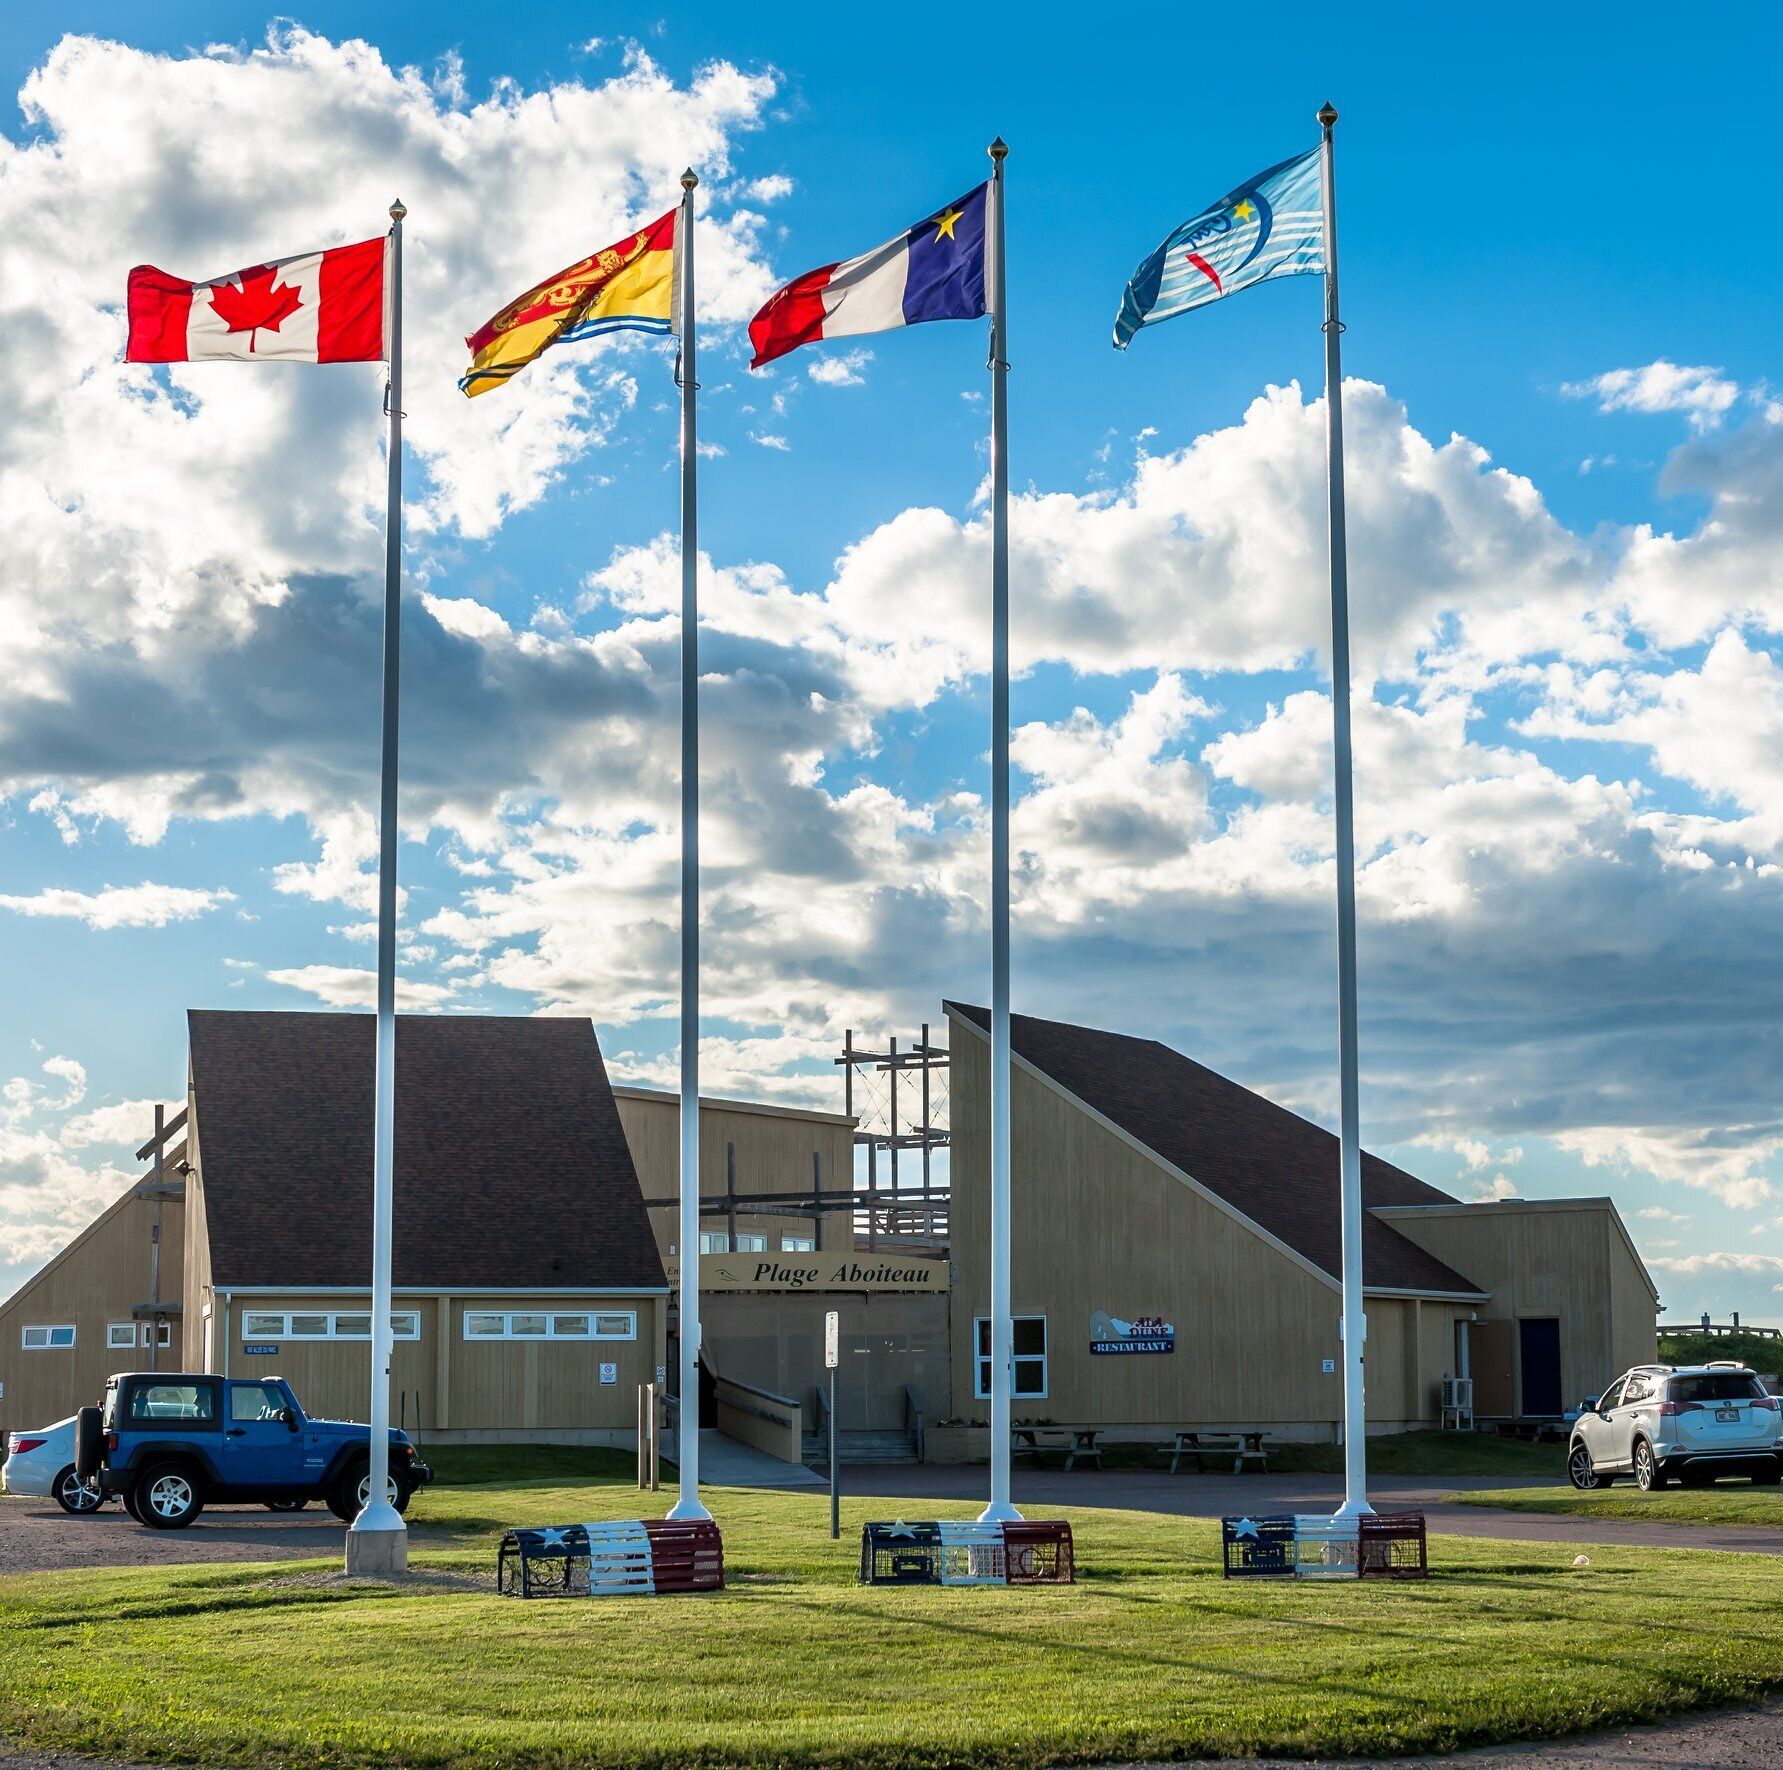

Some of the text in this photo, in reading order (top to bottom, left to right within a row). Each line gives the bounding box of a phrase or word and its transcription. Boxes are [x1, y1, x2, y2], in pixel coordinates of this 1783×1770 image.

[752, 1263, 930, 1287] Plage Aboiteau
[1129, 1327, 1168, 1339] DUNE
[1097, 1342, 1167, 1352] RESTAURANT
